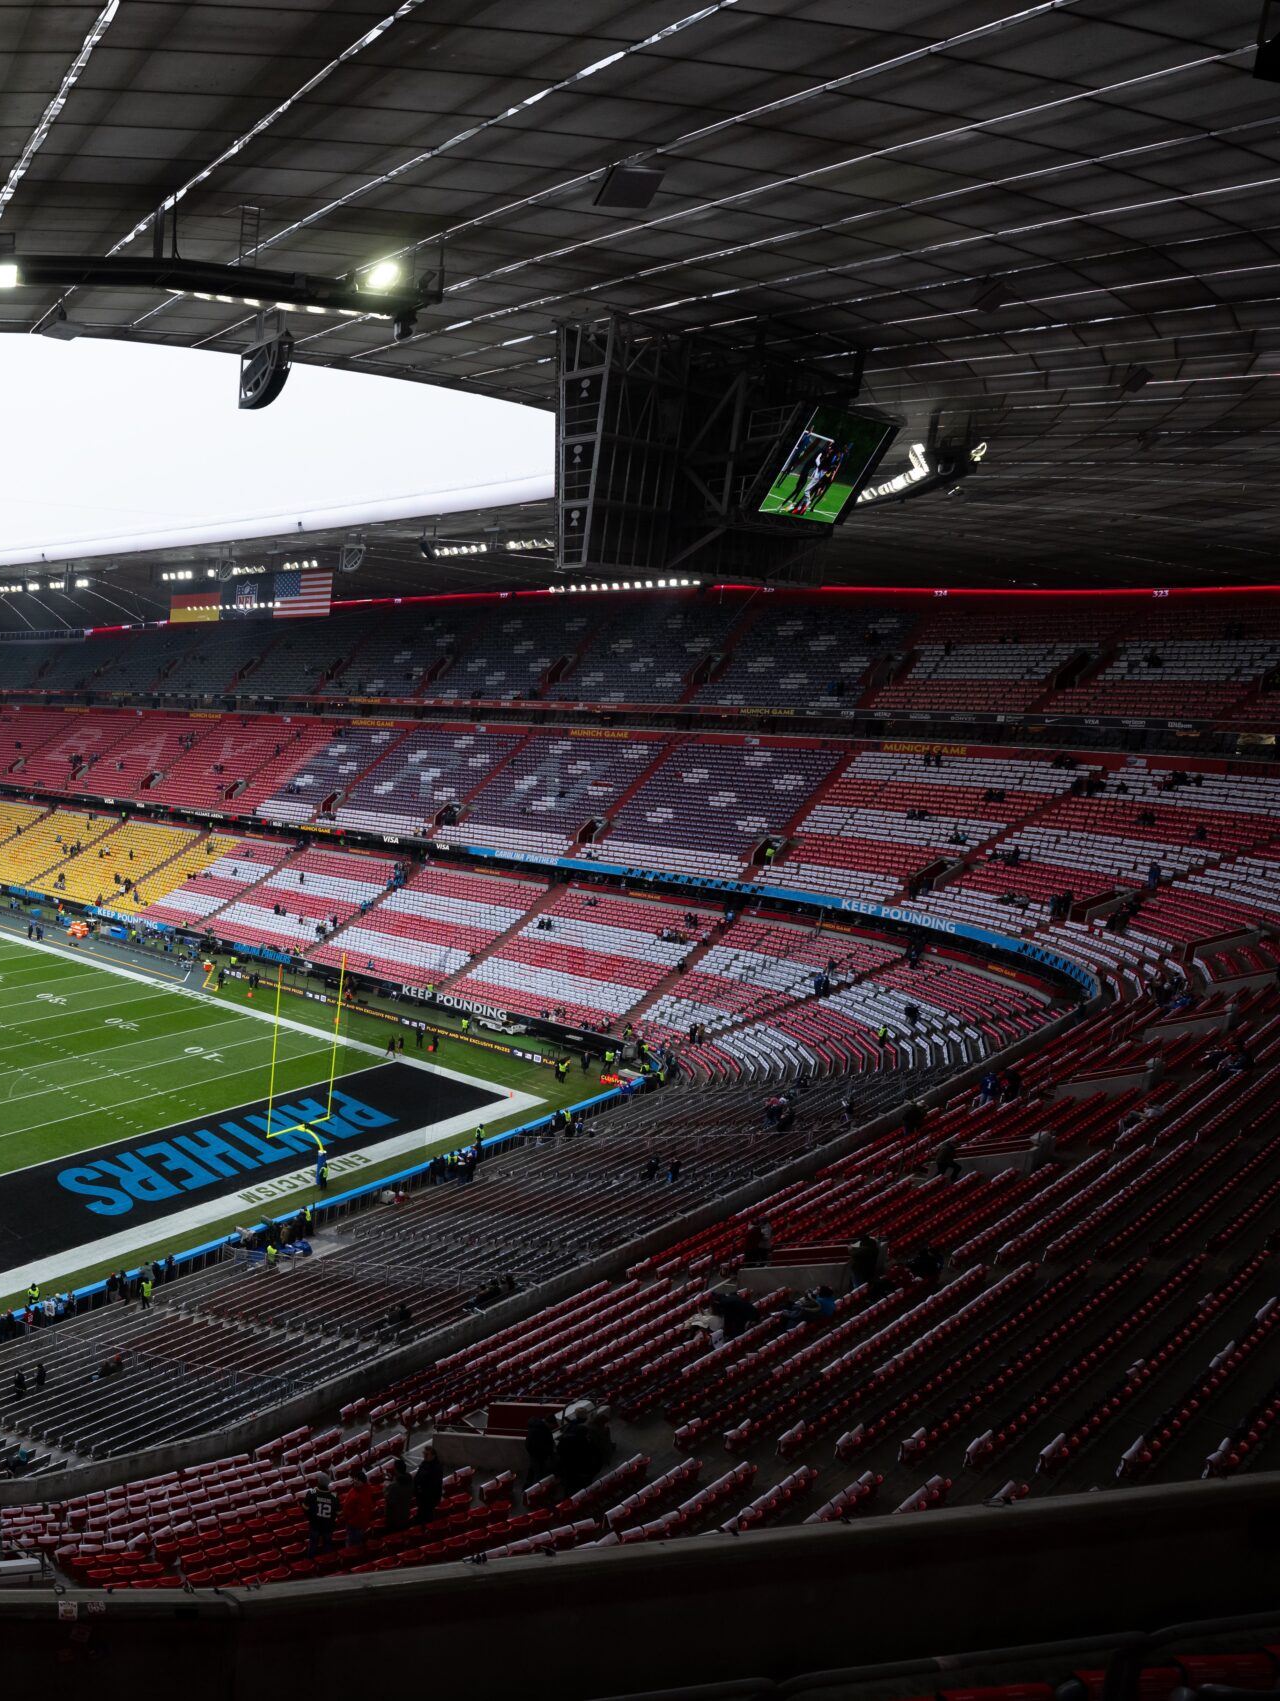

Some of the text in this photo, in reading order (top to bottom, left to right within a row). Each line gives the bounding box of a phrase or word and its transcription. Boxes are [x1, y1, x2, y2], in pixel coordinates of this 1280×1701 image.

[1152, 589, 1169, 598] 323
[740, 708, 795, 717] MUNICH GAME
[352, 719, 394, 728] MUNICH GAME
[570, 729, 630, 739] MUNICH GAME
[883, 743, 930, 754] MUNICH
[932, 745, 968, 755] GAME
[383, 835, 399, 844] VISA
[436, 843, 450, 851] VISA
[525, 854, 559, 866] PANTHERS
[97, 907, 118, 920] KEEP
[841, 899, 956, 933] KEEP POUNDING
[234, 942, 291, 964] CAROLINA PANTHERS
[154, 979, 217, 1002] MUNICH
[36, 993, 67, 1005] 30
[402, 984, 508, 1021] KEEP POUNDING
[363, 1008, 384, 1019] EXCLUSIVE
[384, 1014, 399, 1022] PRIZES
[105, 1018, 139, 1032] 20
[437, 1028, 448, 1036] NOW
[449, 1031, 459, 1039] AND
[459, 1034, 469, 1042] WIN
[469, 1037, 494, 1049] EXCLUSIVE
[494, 1043, 510, 1053] PRIZES
[184, 1046, 225, 1063] 10
[543, 1057, 556, 1065] PLAY
[57, 1090, 399, 1216] PANTHERS
[237, 1153, 372, 1205] END RACISM
[316, 1503, 332, 1518] 12
